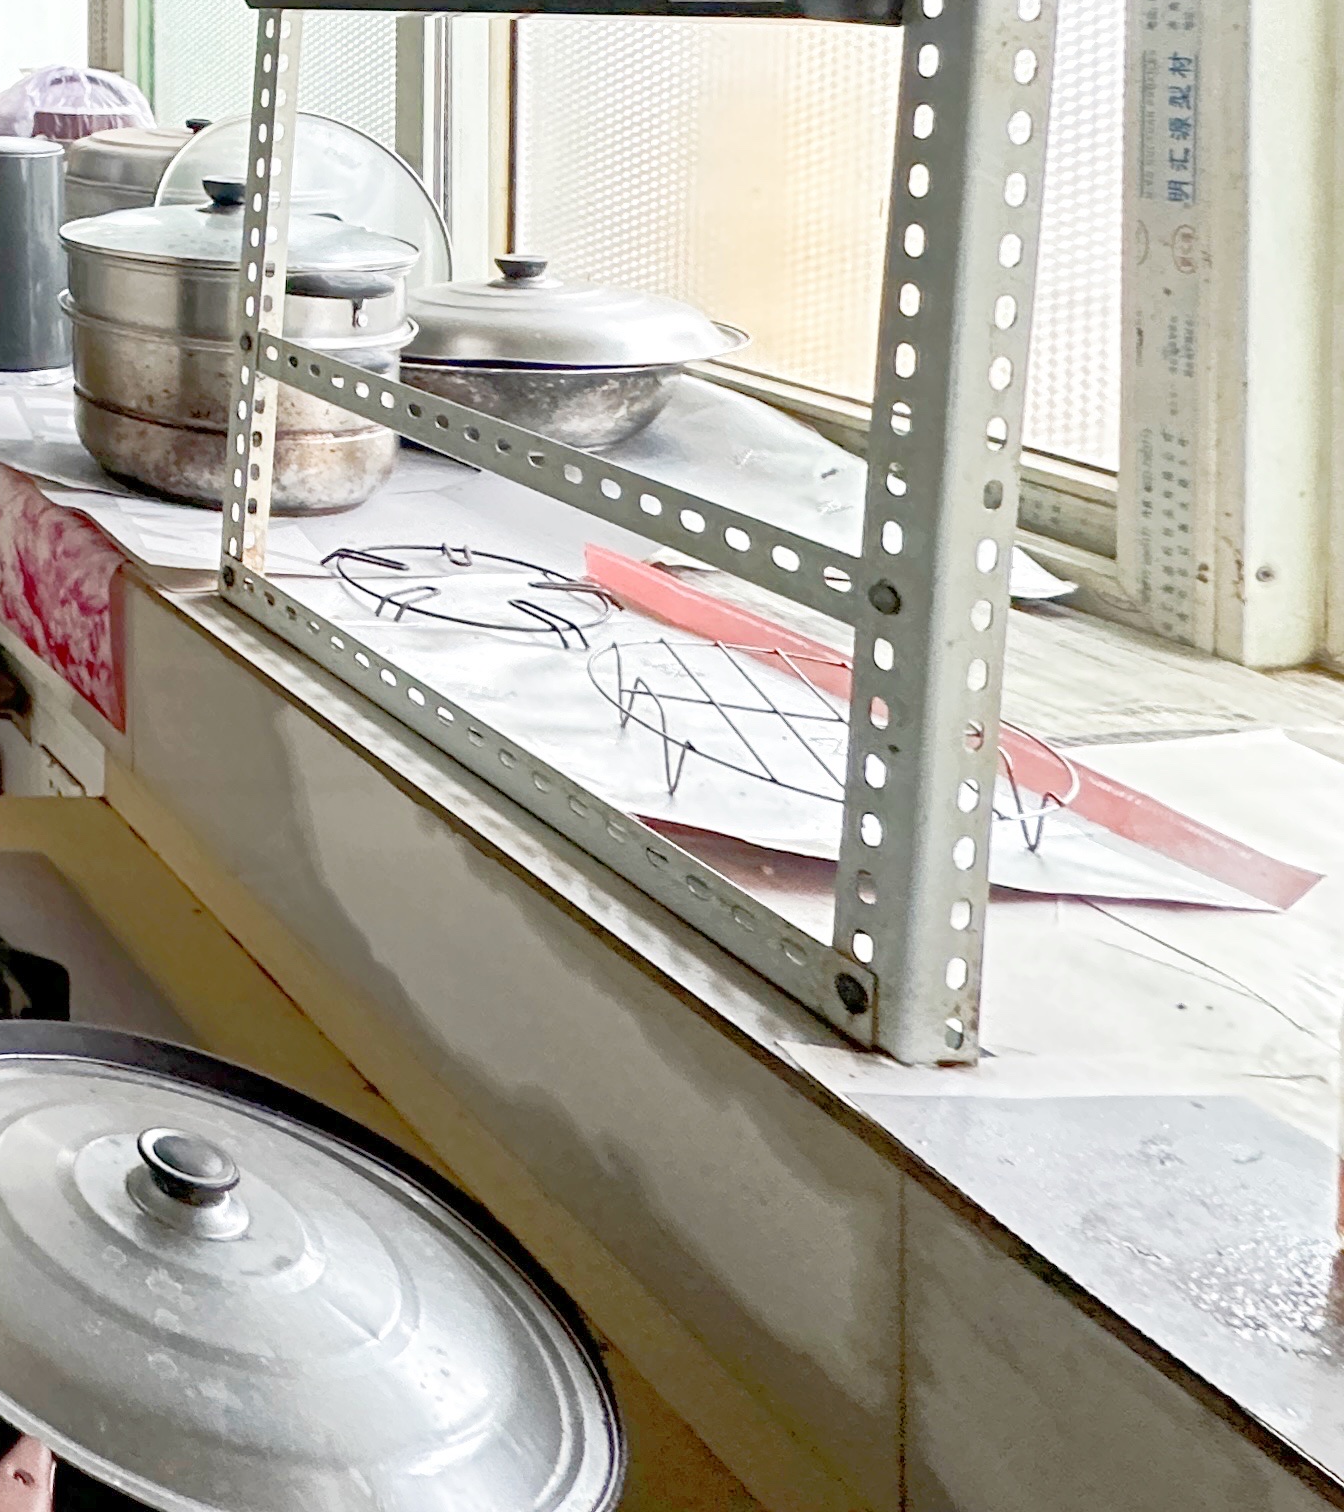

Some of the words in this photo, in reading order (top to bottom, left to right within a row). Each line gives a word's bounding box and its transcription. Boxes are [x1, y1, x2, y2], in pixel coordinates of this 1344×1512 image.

[1166, 53, 1194, 202] 明汇源型材
